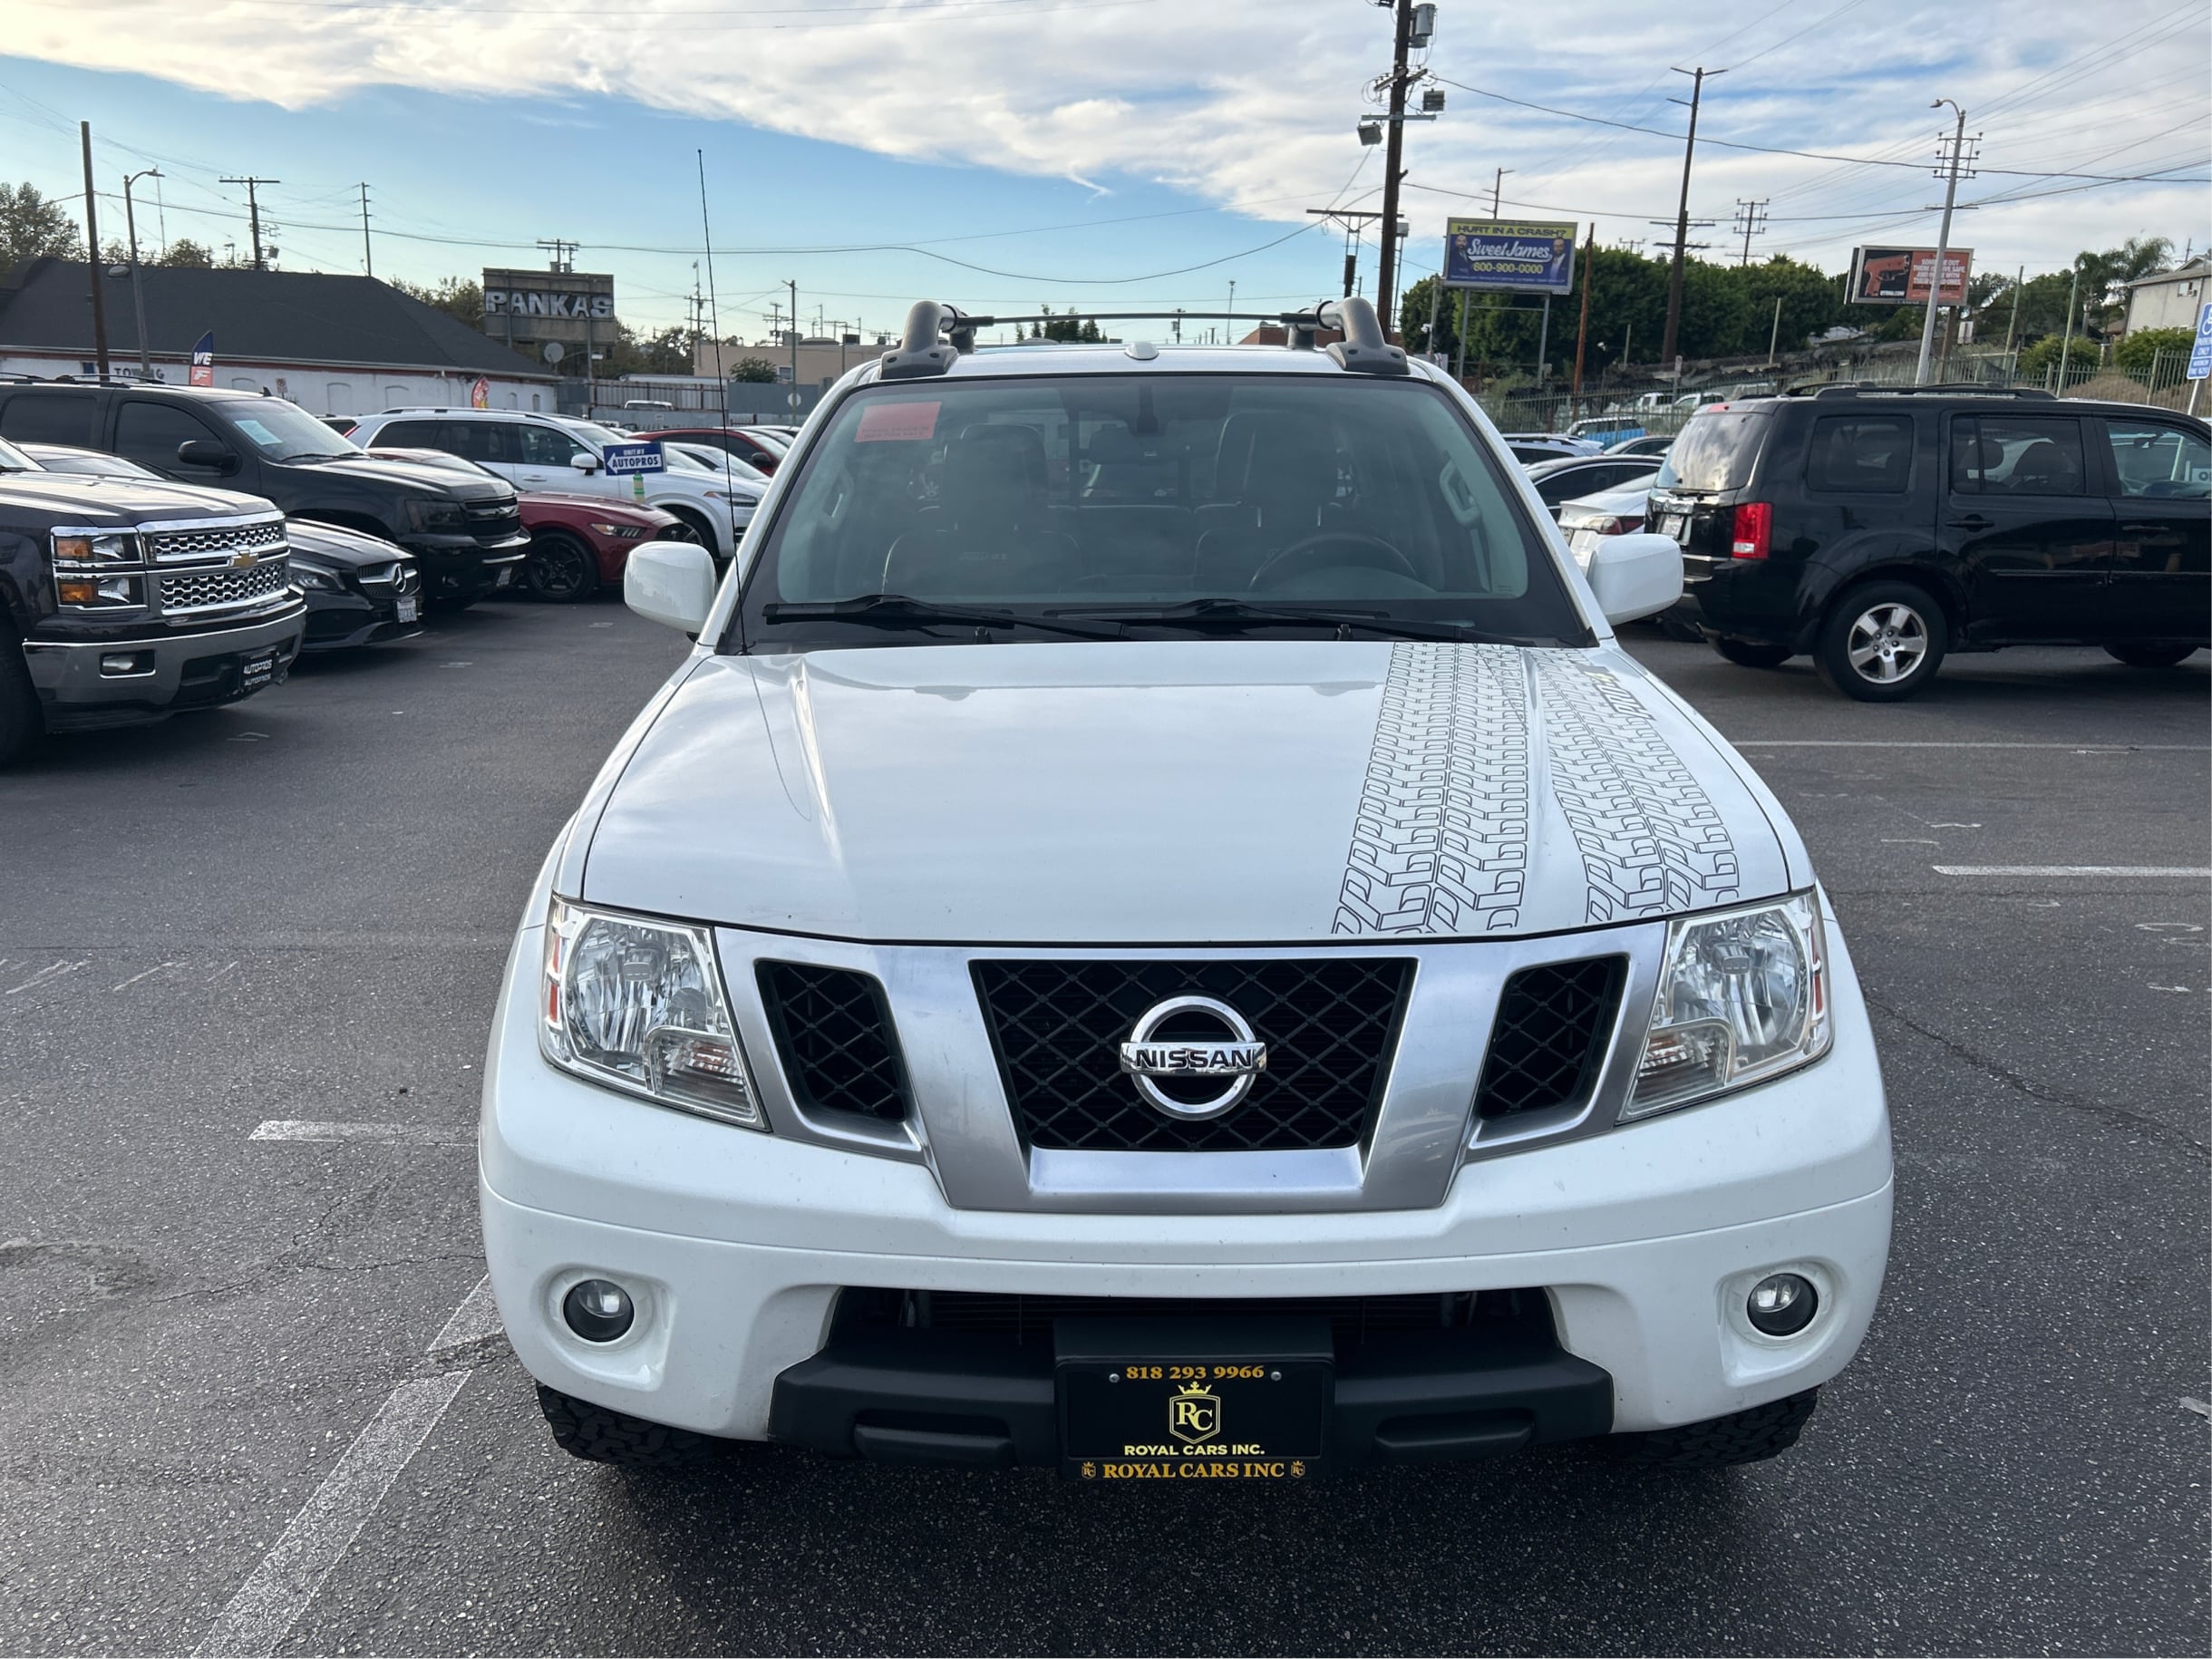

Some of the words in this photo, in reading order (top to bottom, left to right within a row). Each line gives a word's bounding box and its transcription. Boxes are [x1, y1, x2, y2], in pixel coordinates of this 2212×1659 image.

[1457, 226, 1489, 234] HURT
[1517, 228, 1567, 238] CRASH?
[1473, 262, 1543, 274] 800-900-0000
[485, 289, 613, 318] PANKAS
[193, 352, 213, 365] WE
[613, 456, 658, 468] AUTOPROS
[1136, 1049, 1252, 1069] NISSAN
[1126, 1366, 1163, 1380] 818
[1169, 1366, 1207, 1379] 293
[1213, 1365, 1265, 1379] 9966
[1176, 1402, 1213, 1431] RC
[1124, 1445, 1179, 1456] ROYAL
[1182, 1444, 1227, 1456] CARS
[1232, 1443, 1266, 1455] INC.
[1102, 1463, 1177, 1479] ROYAL
[1179, 1462, 1239, 1478] CARS
[1243, 1462, 1285, 1478] INC
